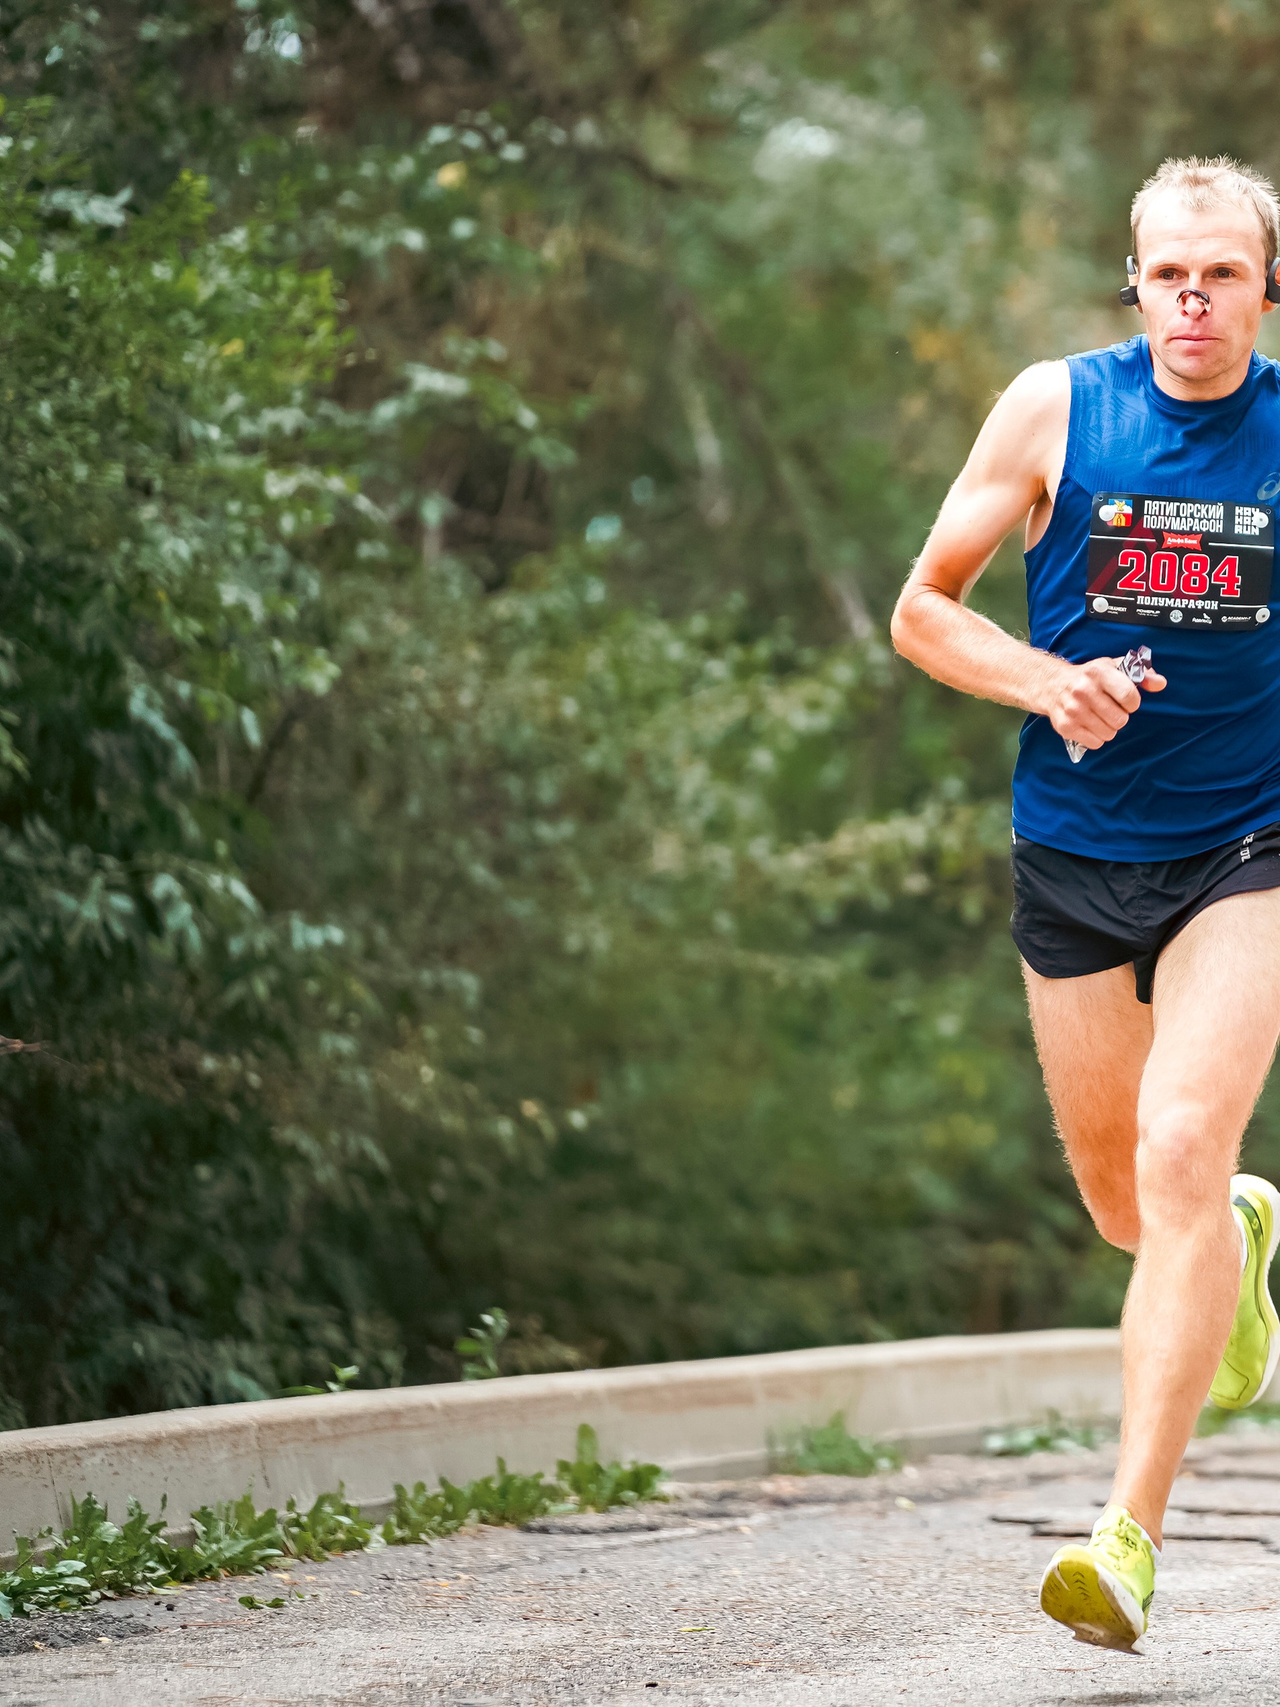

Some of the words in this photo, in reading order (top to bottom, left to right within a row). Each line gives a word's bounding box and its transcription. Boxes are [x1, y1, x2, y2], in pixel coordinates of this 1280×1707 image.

[1144, 500, 1224, 519] ПЯТИГОРСКИЙ
[1143, 515, 1223, 533] ПОЛУМАРАФОН
[1234, 525, 1260, 536] RUN
[1117, 549, 1241, 598] 2084
[1136, 595, 1219, 610] ПОЛУМАРАФОН
